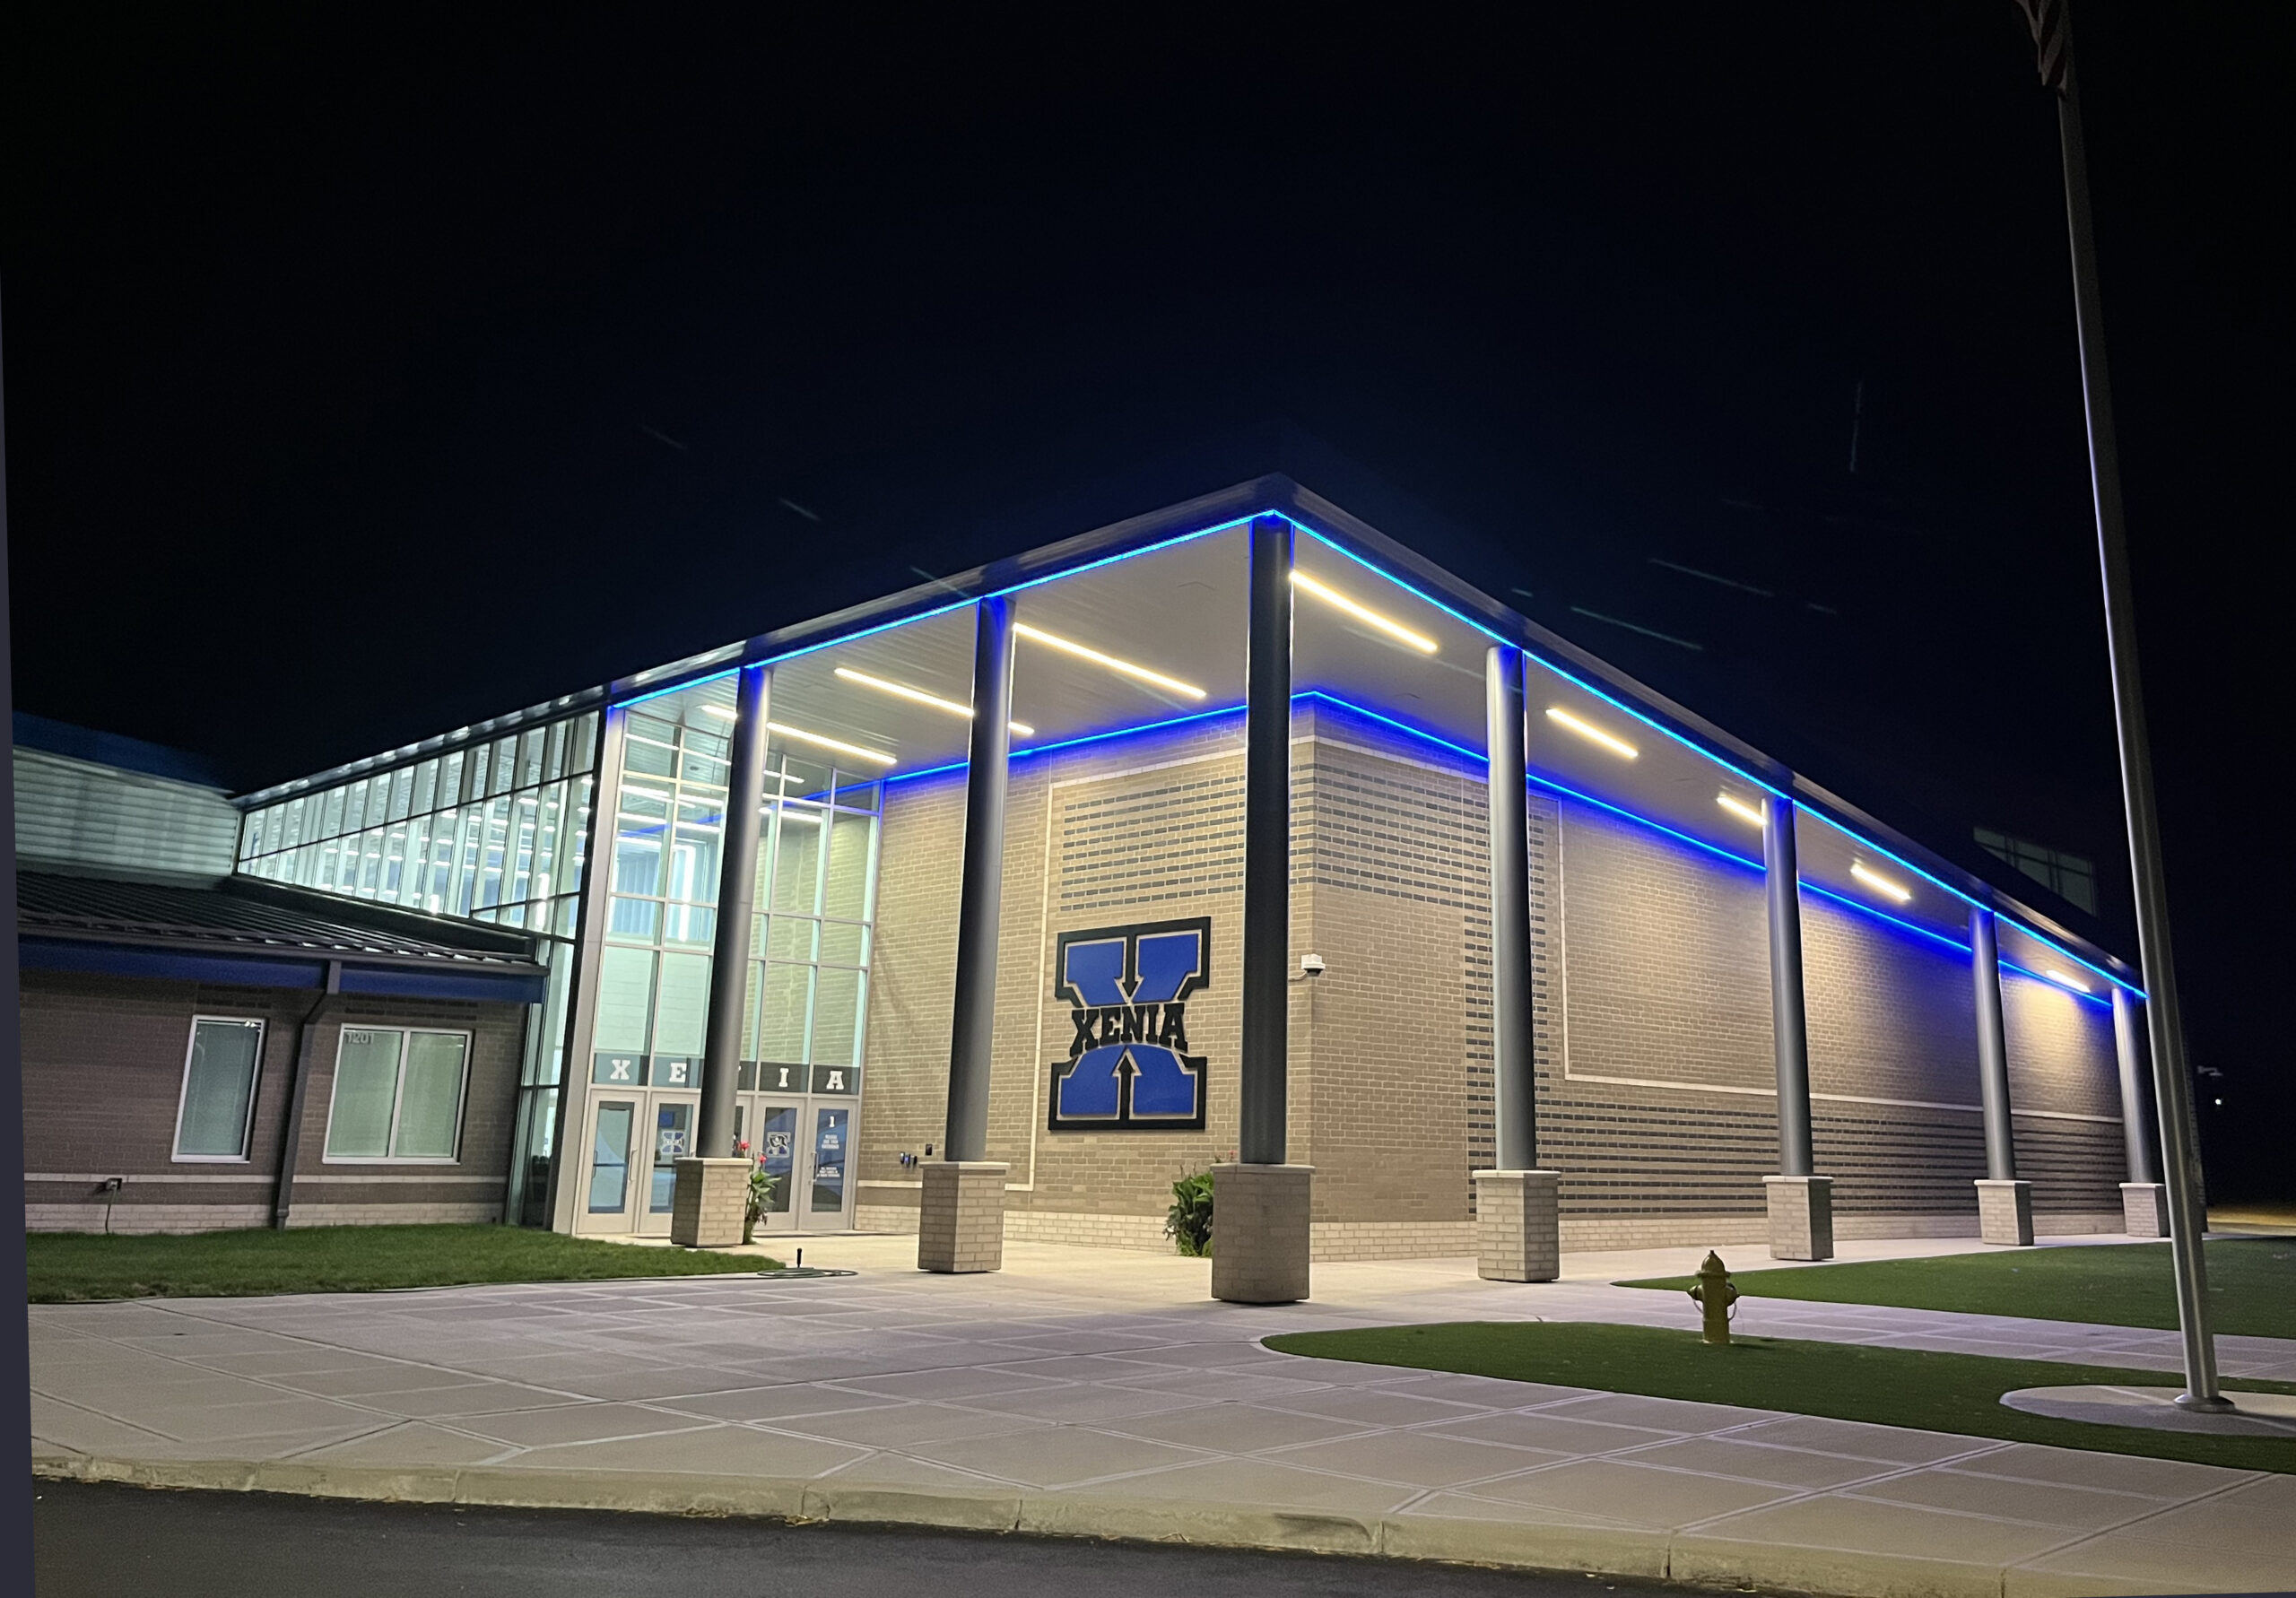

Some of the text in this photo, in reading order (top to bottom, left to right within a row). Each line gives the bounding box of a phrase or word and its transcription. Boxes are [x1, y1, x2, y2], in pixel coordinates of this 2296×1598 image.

[346, 1032, 374, 1044] 1201
[1070, 1003, 1188, 1057] XENIA
[610, 1059, 845, 1090] XEIA
